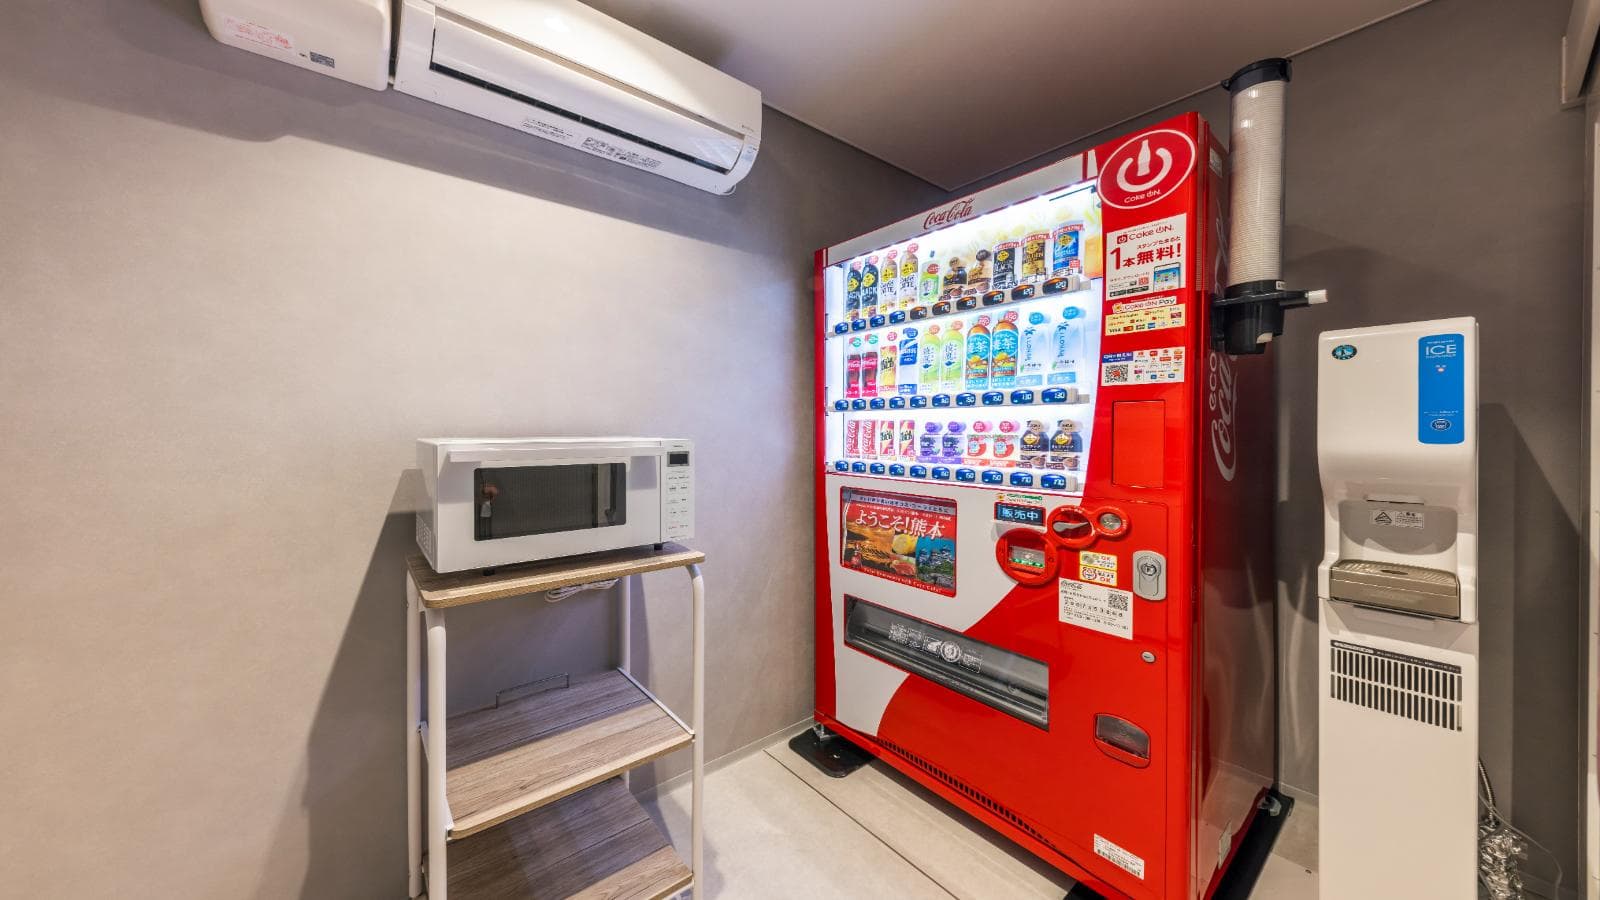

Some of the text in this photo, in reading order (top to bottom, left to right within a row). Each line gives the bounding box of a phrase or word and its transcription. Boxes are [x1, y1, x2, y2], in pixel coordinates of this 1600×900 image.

[1124, 193, 1145, 204] Coke
[923, 198, 975, 229] Coca-Cola
[1129, 230, 1154, 240] Coke
[1158, 298, 1176, 306] Pay
[1426, 344, 1457, 356] ICE
[1002, 508, 1039, 520] 販売中
[855, 510, 946, 539] ようこそ!熊本
